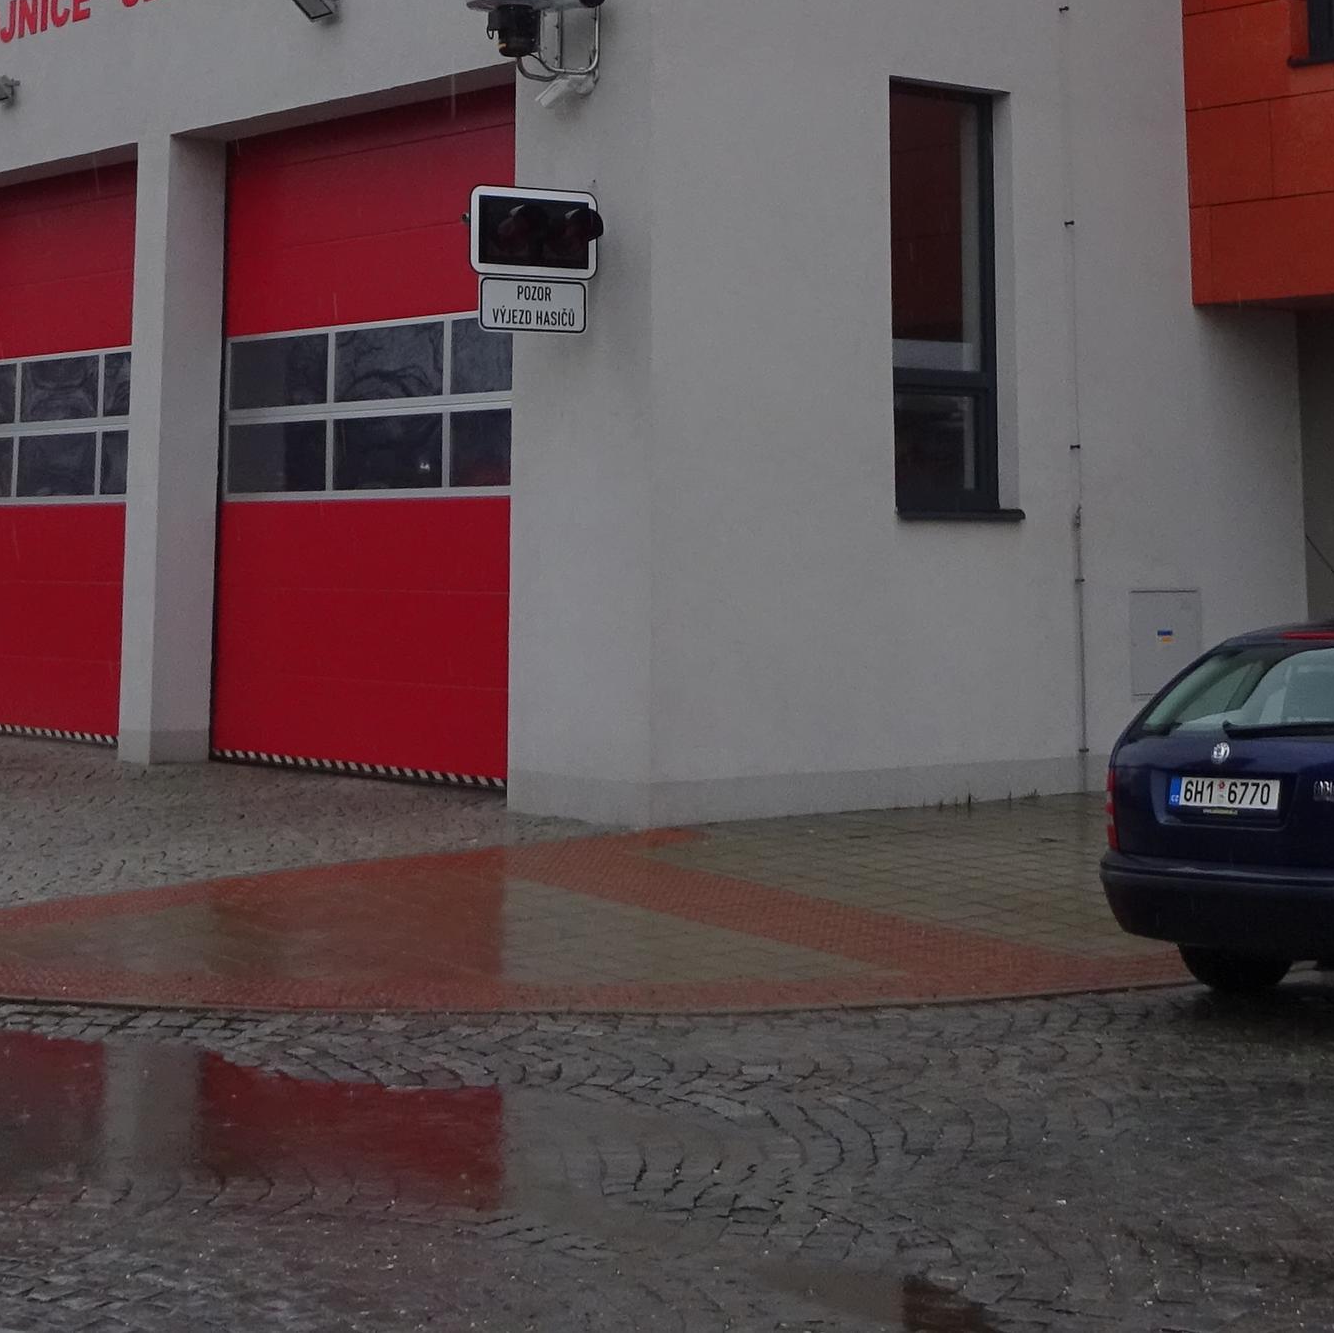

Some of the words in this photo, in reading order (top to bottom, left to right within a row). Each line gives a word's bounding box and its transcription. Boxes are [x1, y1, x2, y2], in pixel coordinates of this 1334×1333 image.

[517, 285, 552, 301] POZOR
[492, 305, 532, 325] VÝJEZD
[535, 308, 575, 327] HASIČŮ
[1183, 780, 1215, 803] 6H1
[1227, 782, 1272, 805] 6770
